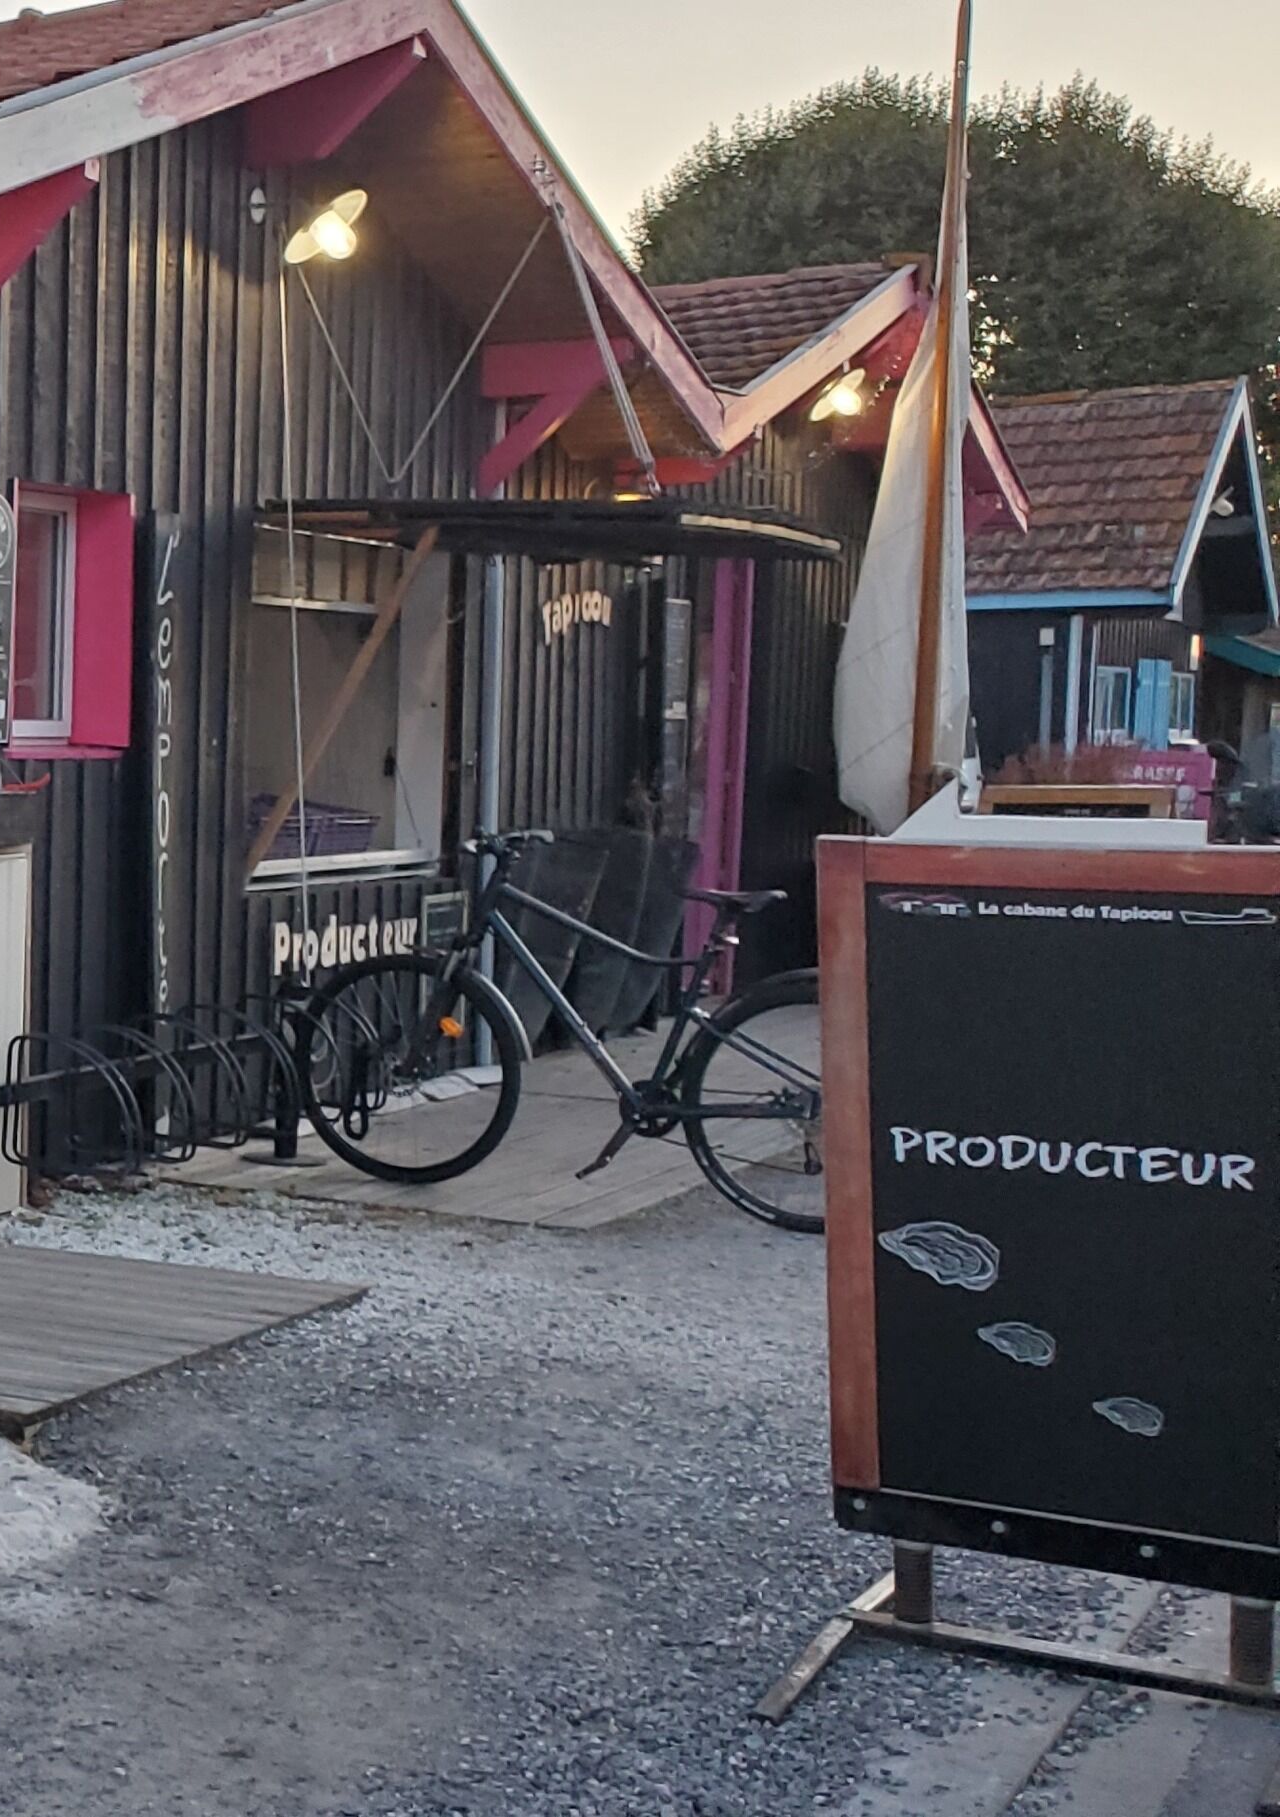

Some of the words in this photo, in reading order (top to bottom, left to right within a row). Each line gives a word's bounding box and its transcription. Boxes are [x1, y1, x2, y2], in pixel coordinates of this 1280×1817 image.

[978, 902, 999, 915] La
[1003, 903, 1068, 918] cabane
[1071, 904, 1095, 918] du
[273, 914, 418, 976] Producteur
[890, 1126, 1256, 1191] PRODUCTEUR
